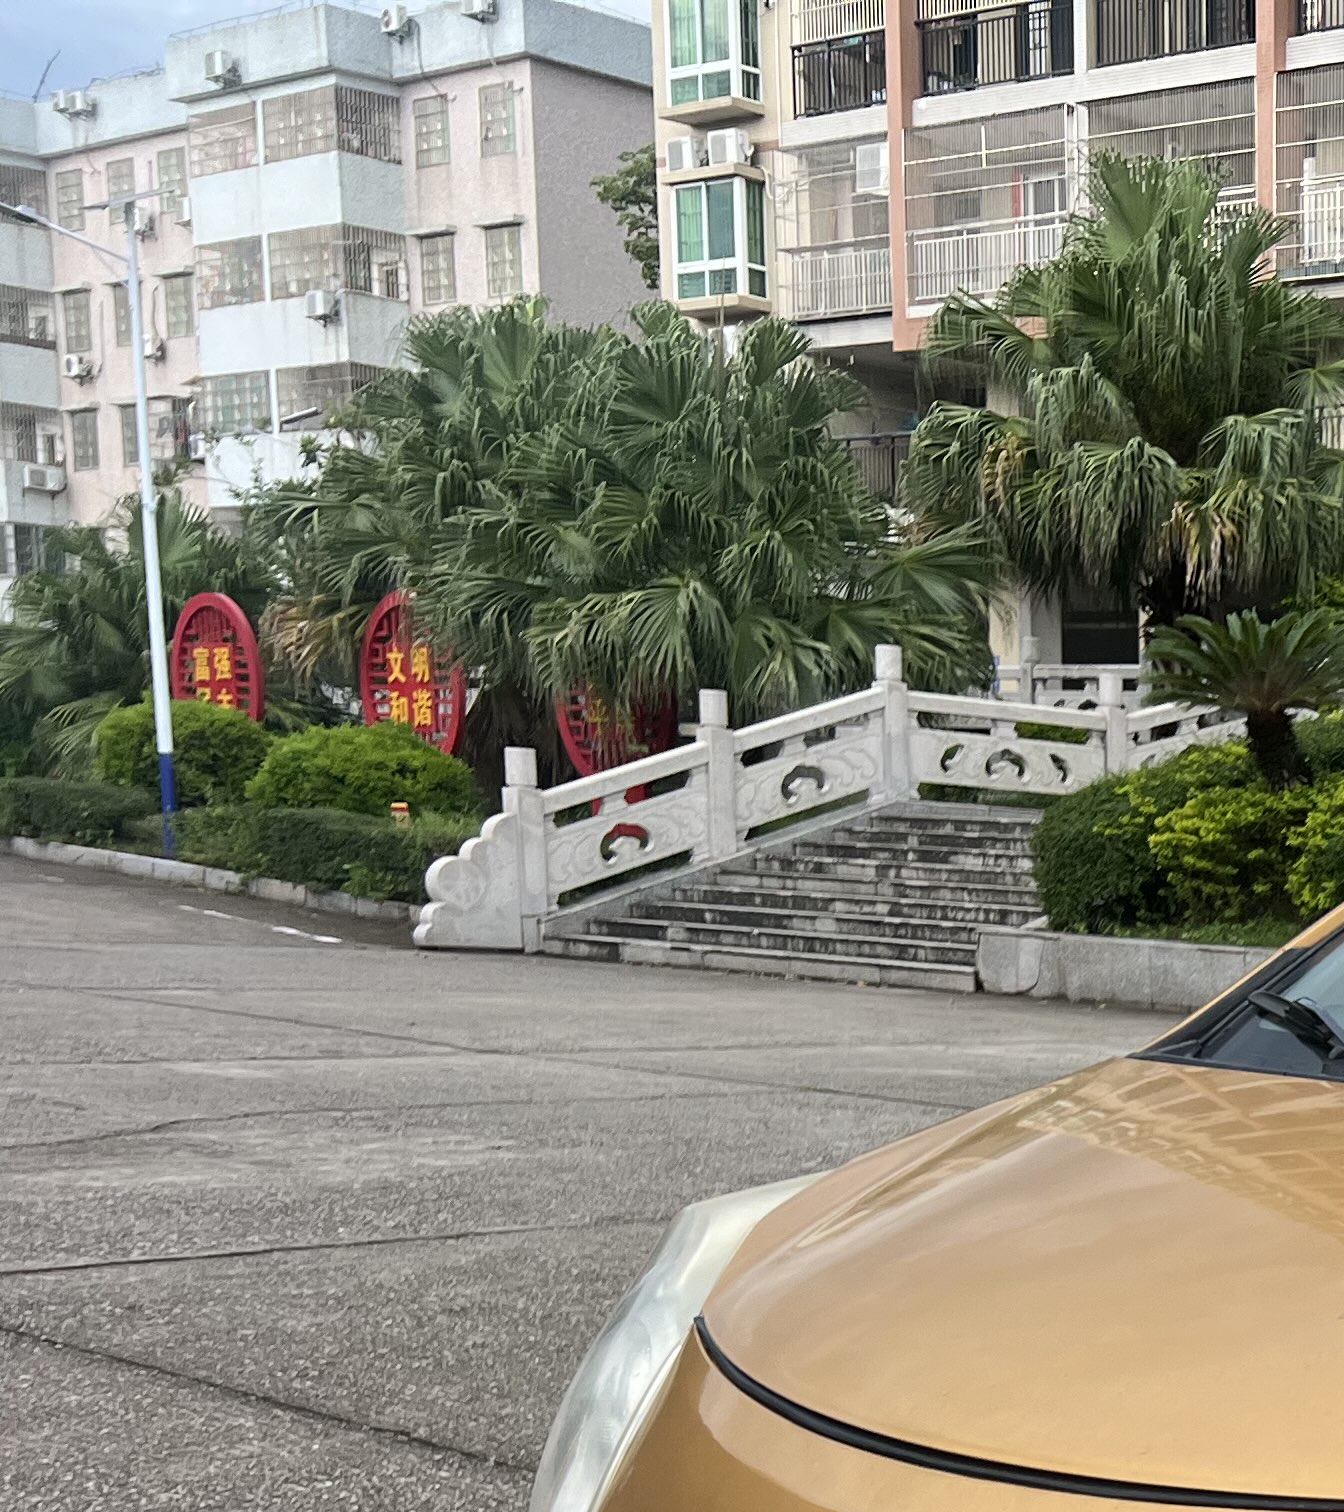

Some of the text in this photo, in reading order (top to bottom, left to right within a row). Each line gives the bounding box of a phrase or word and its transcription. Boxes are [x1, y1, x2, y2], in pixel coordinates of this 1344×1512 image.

[193, 647, 232, 680] 富强
[386, 643, 430, 682] 文明
[390, 689, 432, 727] 和谐
